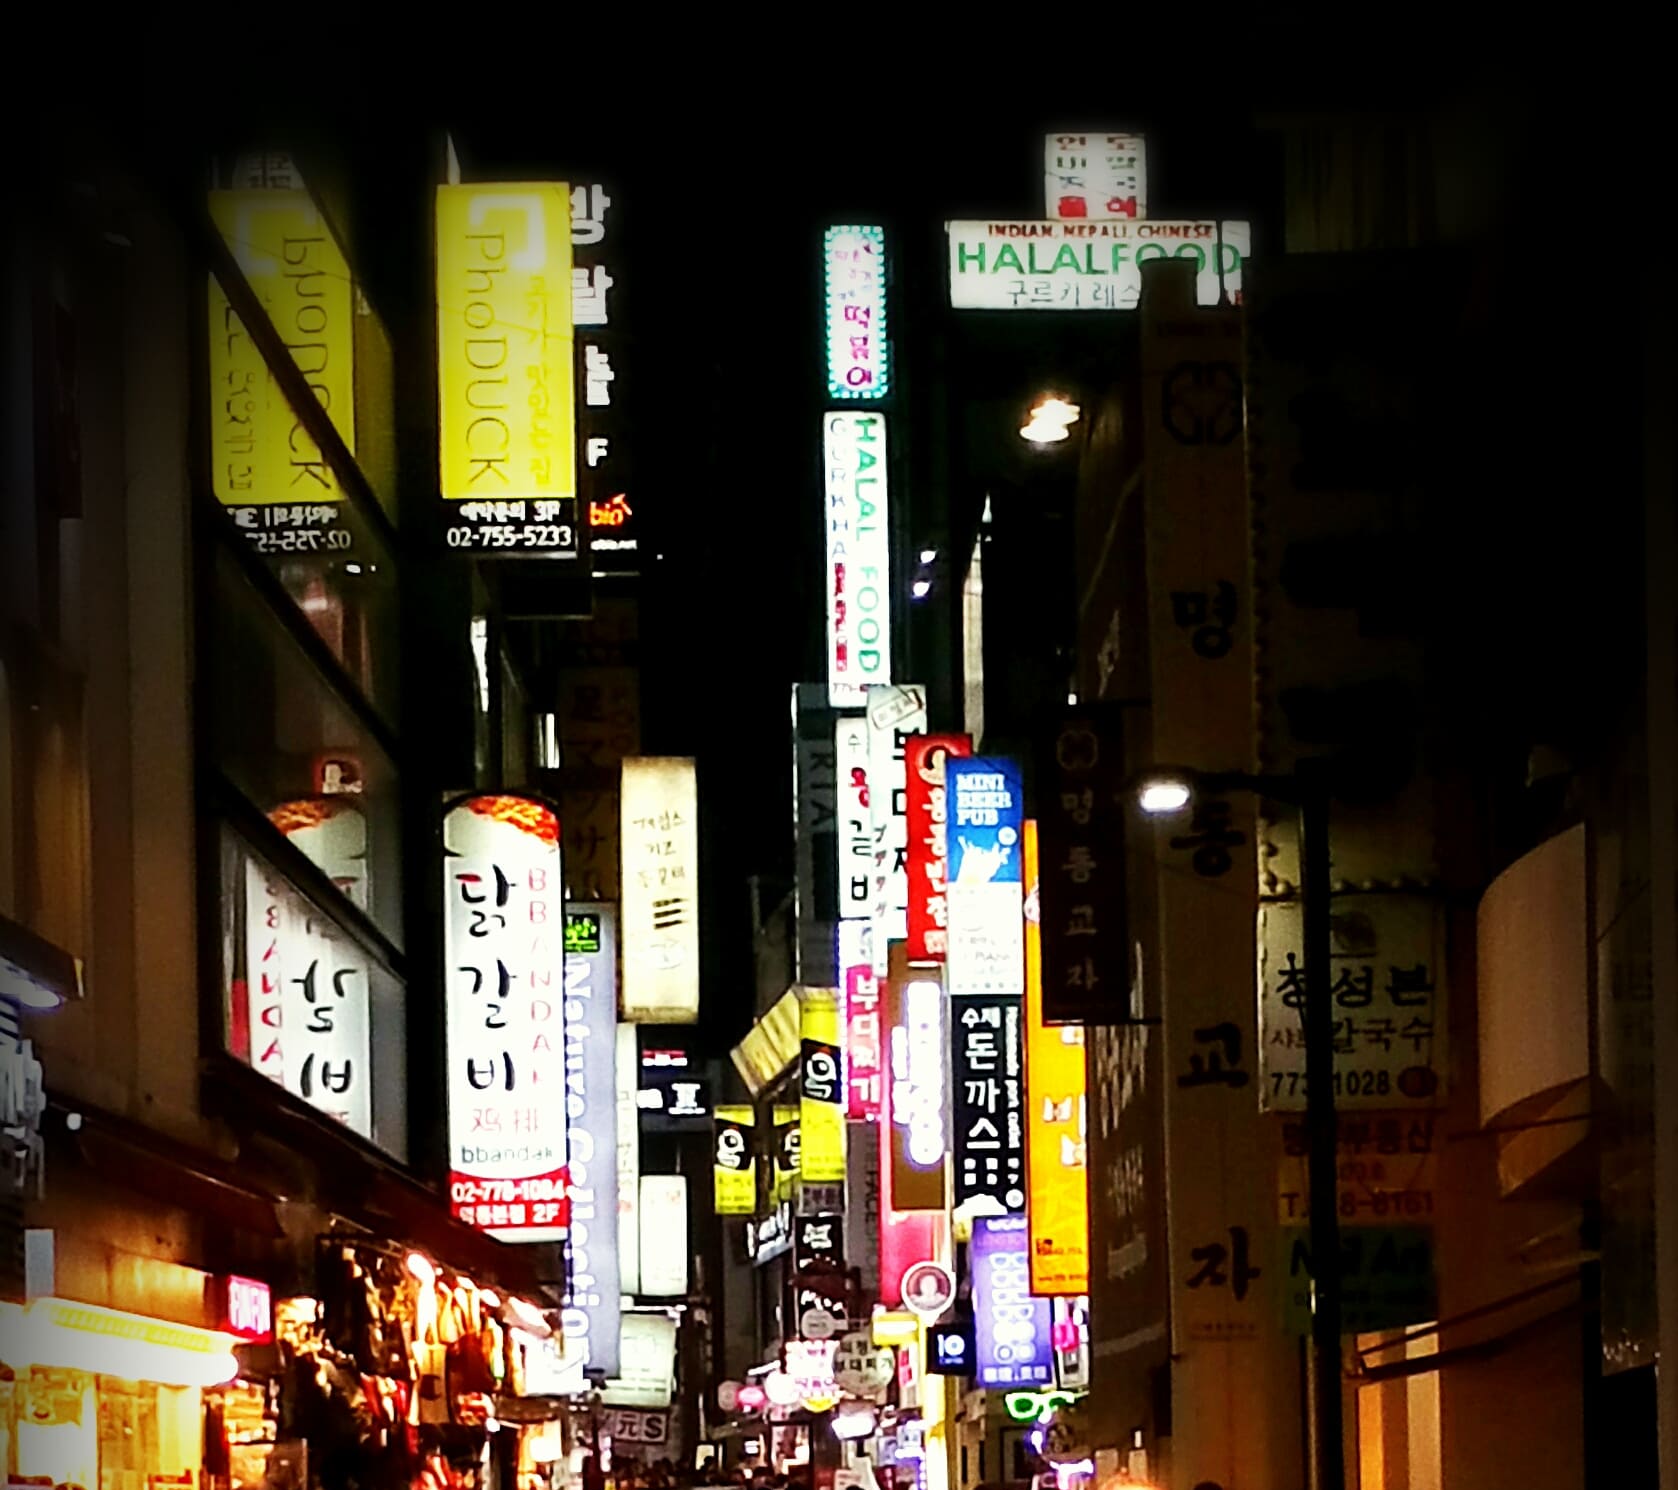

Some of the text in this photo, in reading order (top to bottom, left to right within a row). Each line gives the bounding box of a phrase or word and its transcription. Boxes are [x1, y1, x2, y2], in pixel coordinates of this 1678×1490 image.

[1137, 224, 1213, 238] CHINESE
[854, 417, 878, 542] HALAL
[446, 525, 572, 547] 02-755-5233
[856, 566, 881, 673] FOOD
[956, 773, 1005, 791] MINI
[956, 791, 1013, 809] BEER
[956, 808, 999, 826] PUB
[455, 864, 518, 1091] 닭갈비
[964, 1032, 1002, 1150] 돈까스
[532, 1203, 560, 1223] 2F
